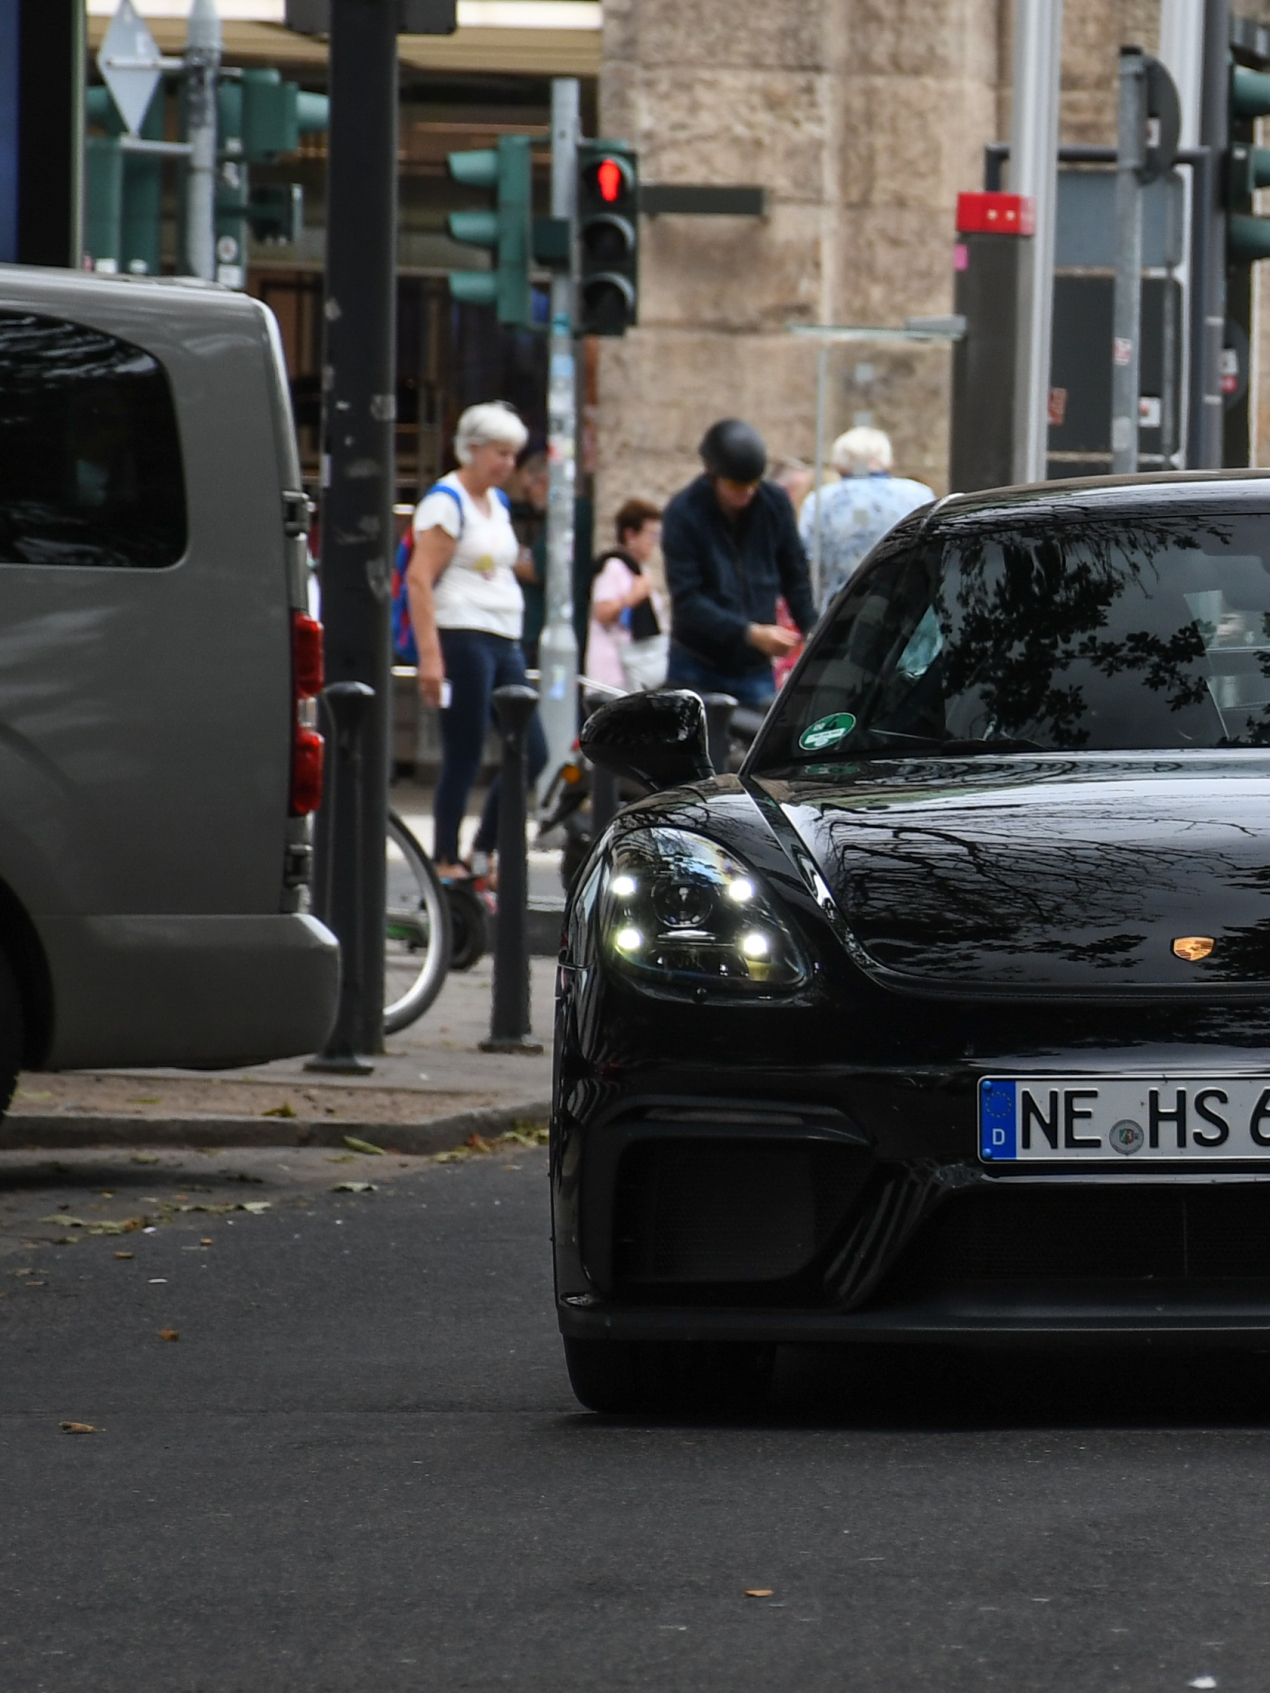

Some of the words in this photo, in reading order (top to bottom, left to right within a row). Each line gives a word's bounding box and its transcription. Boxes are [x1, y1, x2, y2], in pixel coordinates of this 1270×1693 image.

[992, 1127, 1005, 1145] D
[1021, 1087, 1102, 1149] NE
[1148, 1087, 1230, 1148] HS
